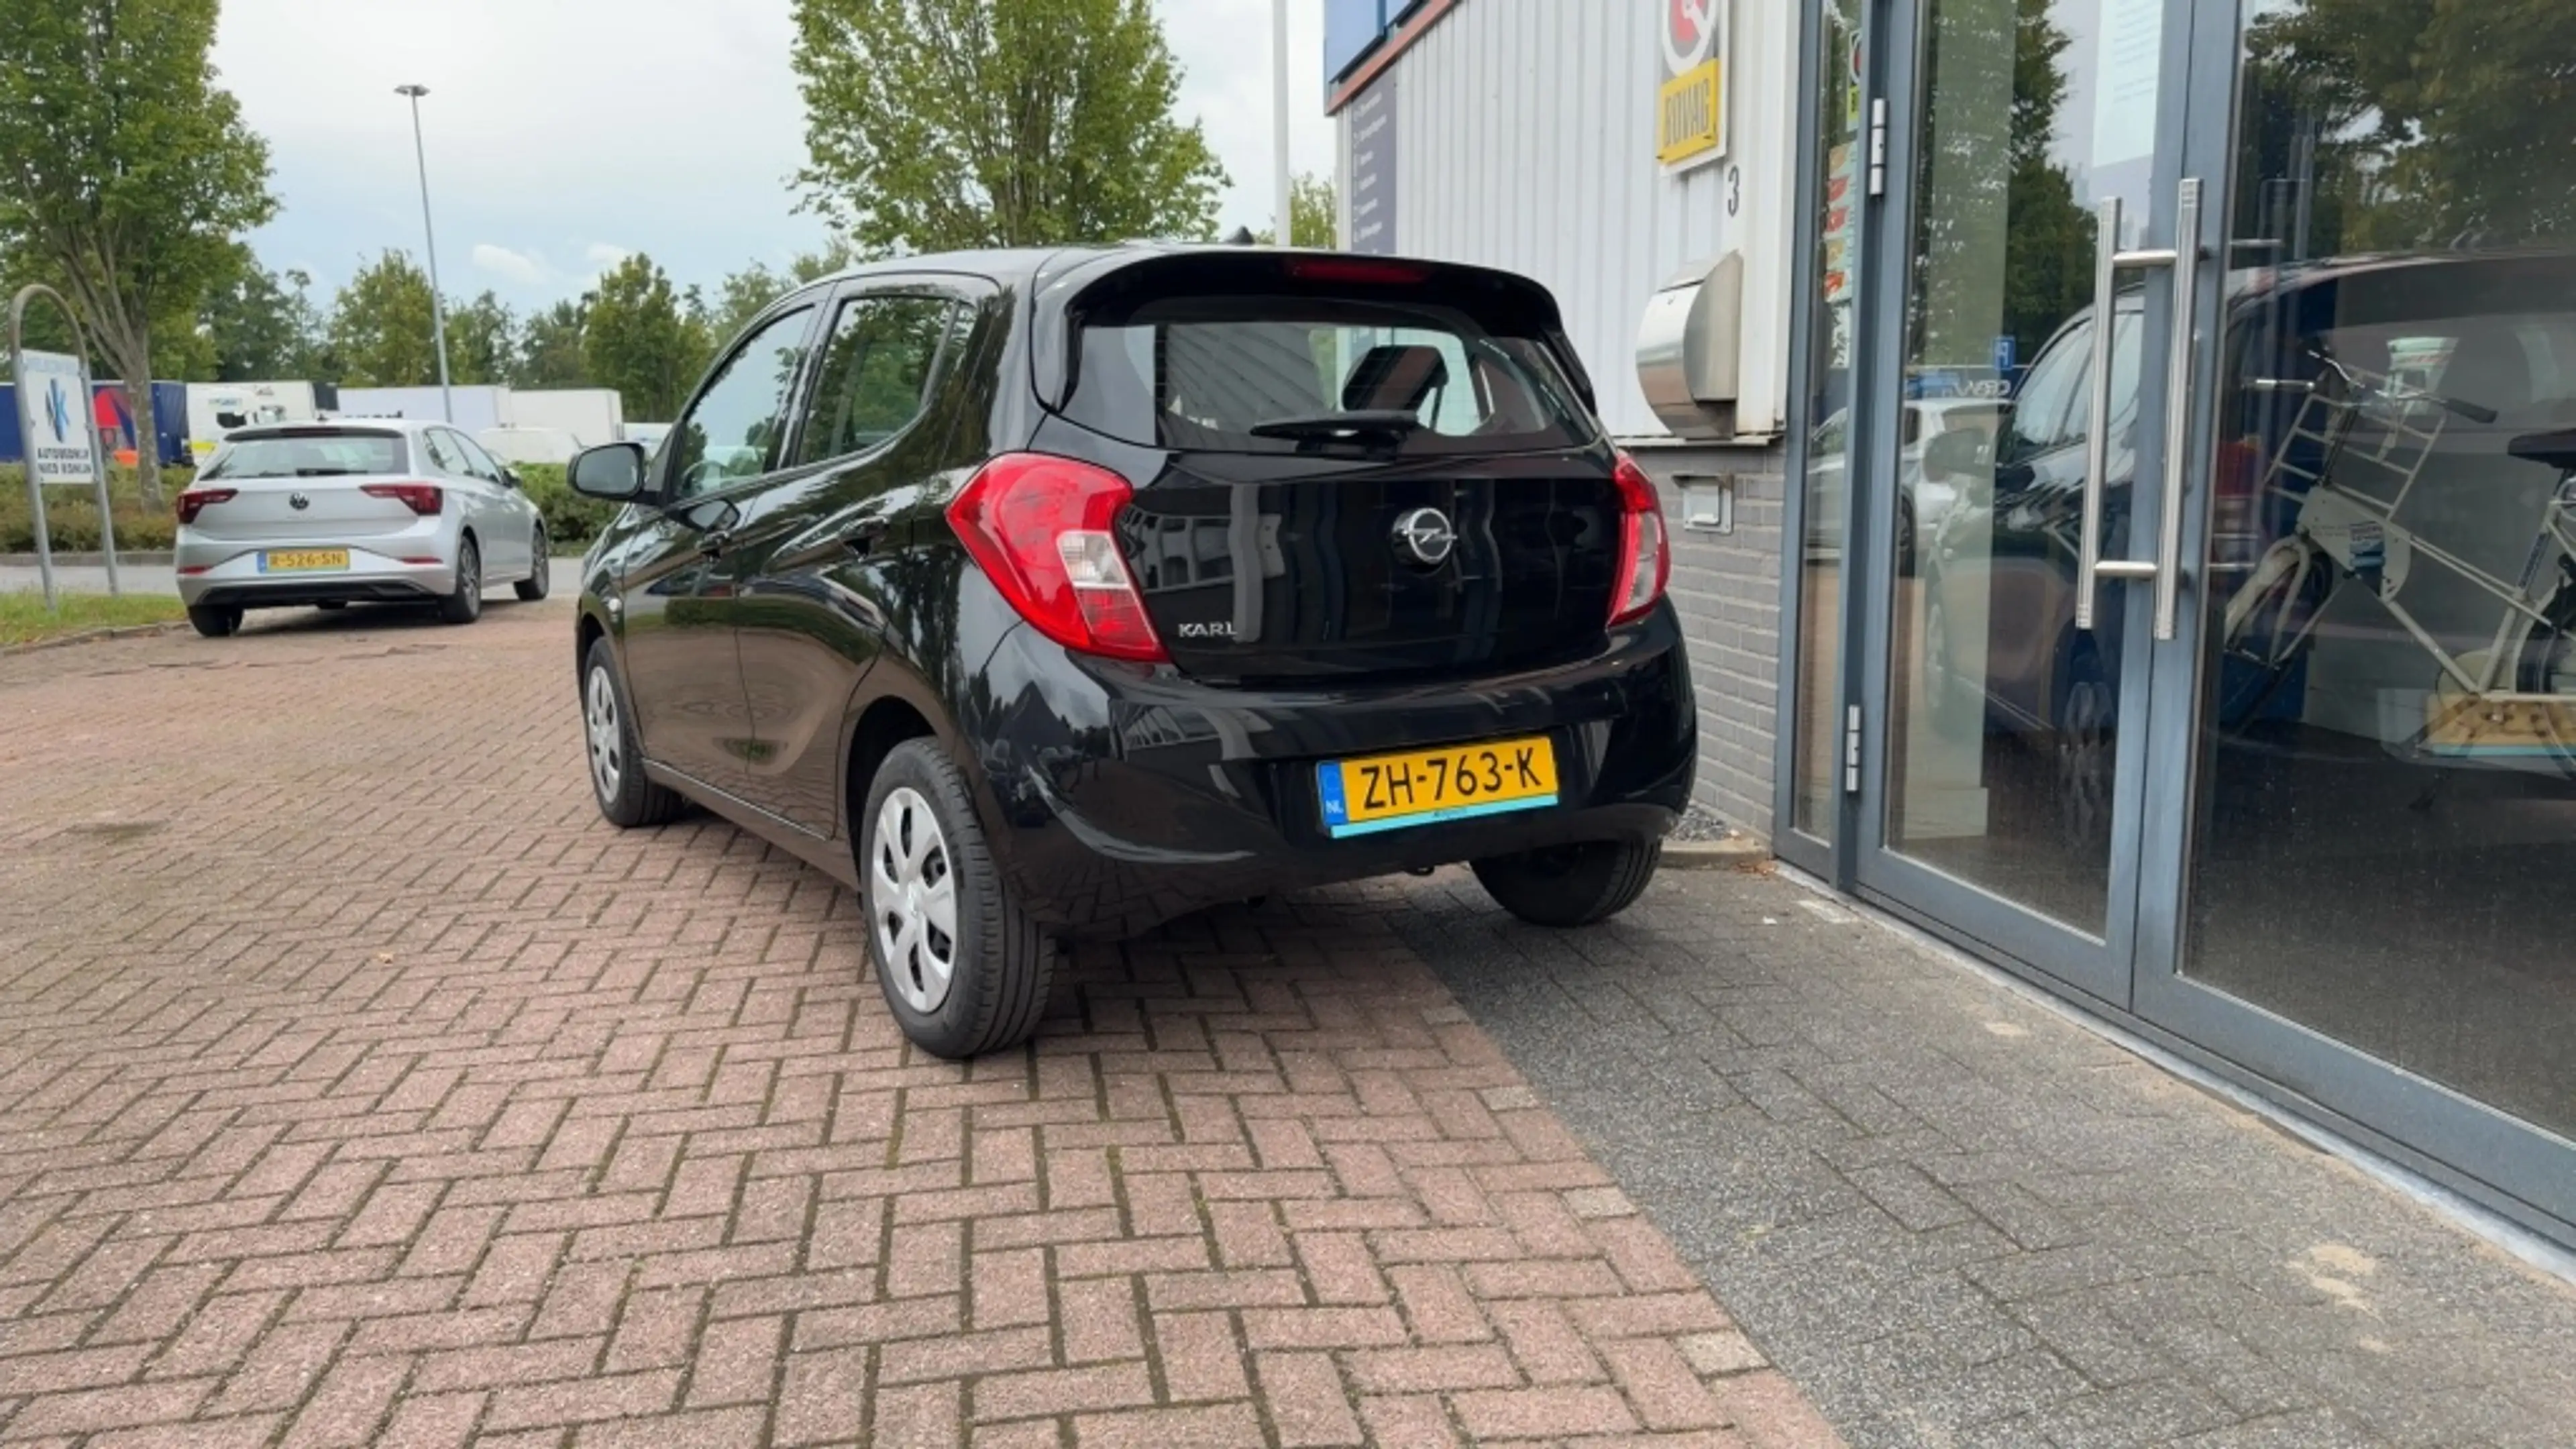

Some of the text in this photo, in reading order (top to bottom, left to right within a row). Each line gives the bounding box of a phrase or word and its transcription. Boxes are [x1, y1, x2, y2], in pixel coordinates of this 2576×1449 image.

[1664, 77, 1711, 147] BOVAG
[1727, 164, 1739, 217] 3
[1178, 621, 1238, 638] KARL
[1360, 747, 1542, 810] ZH-763-K
[1326, 800, 1344, 814] NL
